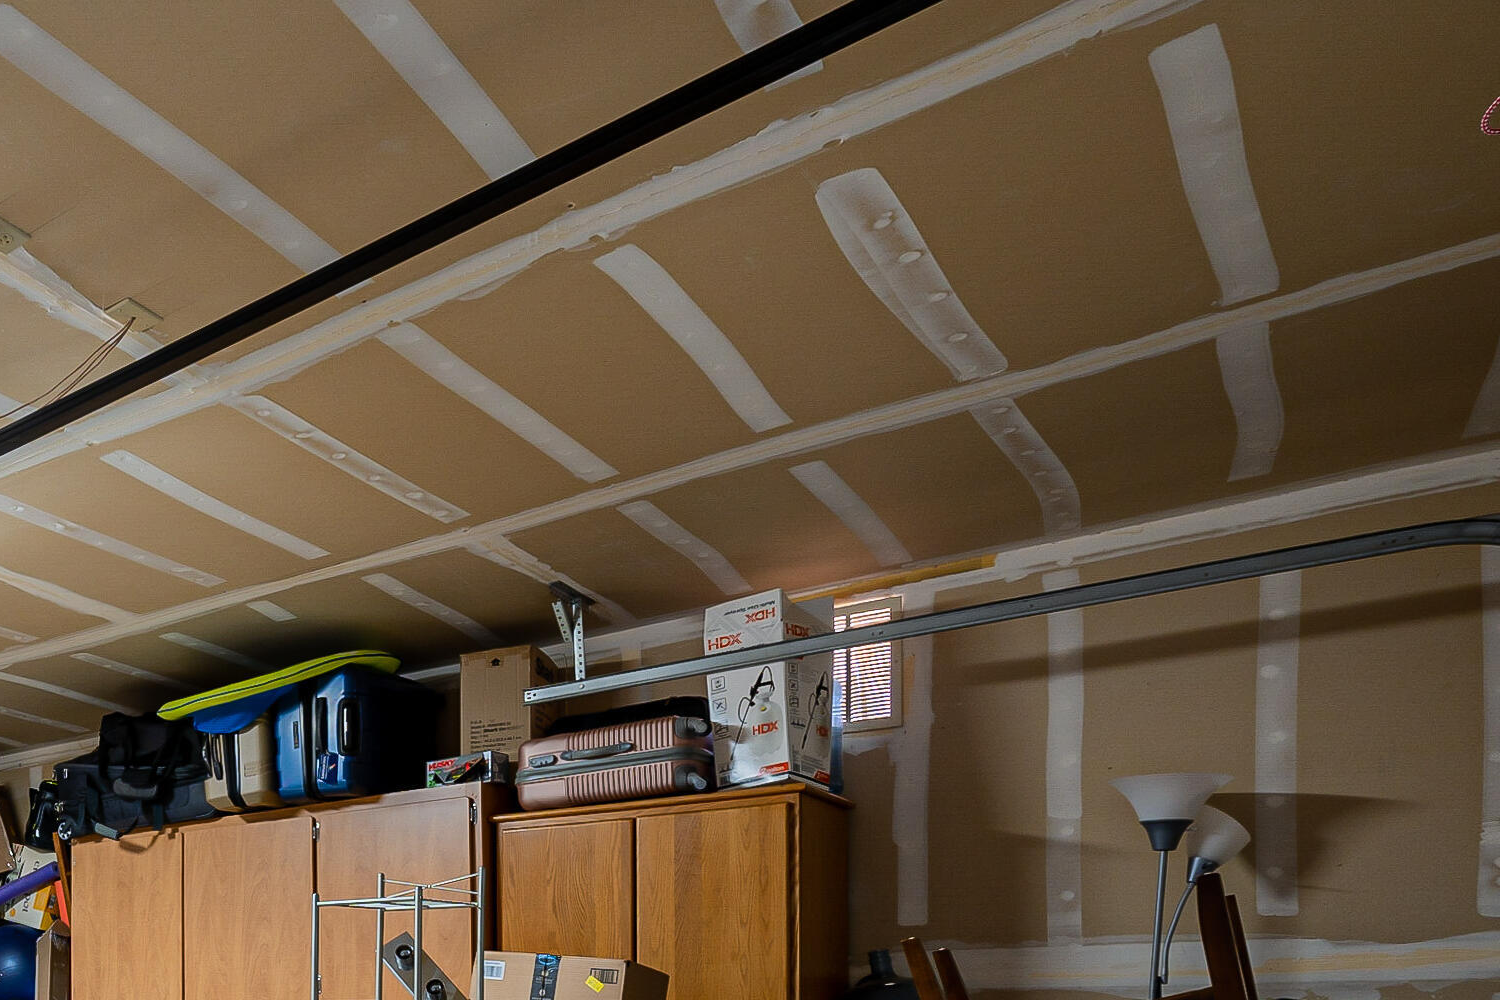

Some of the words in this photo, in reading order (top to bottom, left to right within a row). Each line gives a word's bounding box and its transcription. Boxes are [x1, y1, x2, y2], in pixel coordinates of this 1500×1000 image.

[745, 606, 776, 624] HDX
[785, 623, 811, 639] HDX
[707, 632, 742, 651] HDX
[752, 721, 778, 735] HDX
[428, 759, 455, 771] HUSKY
